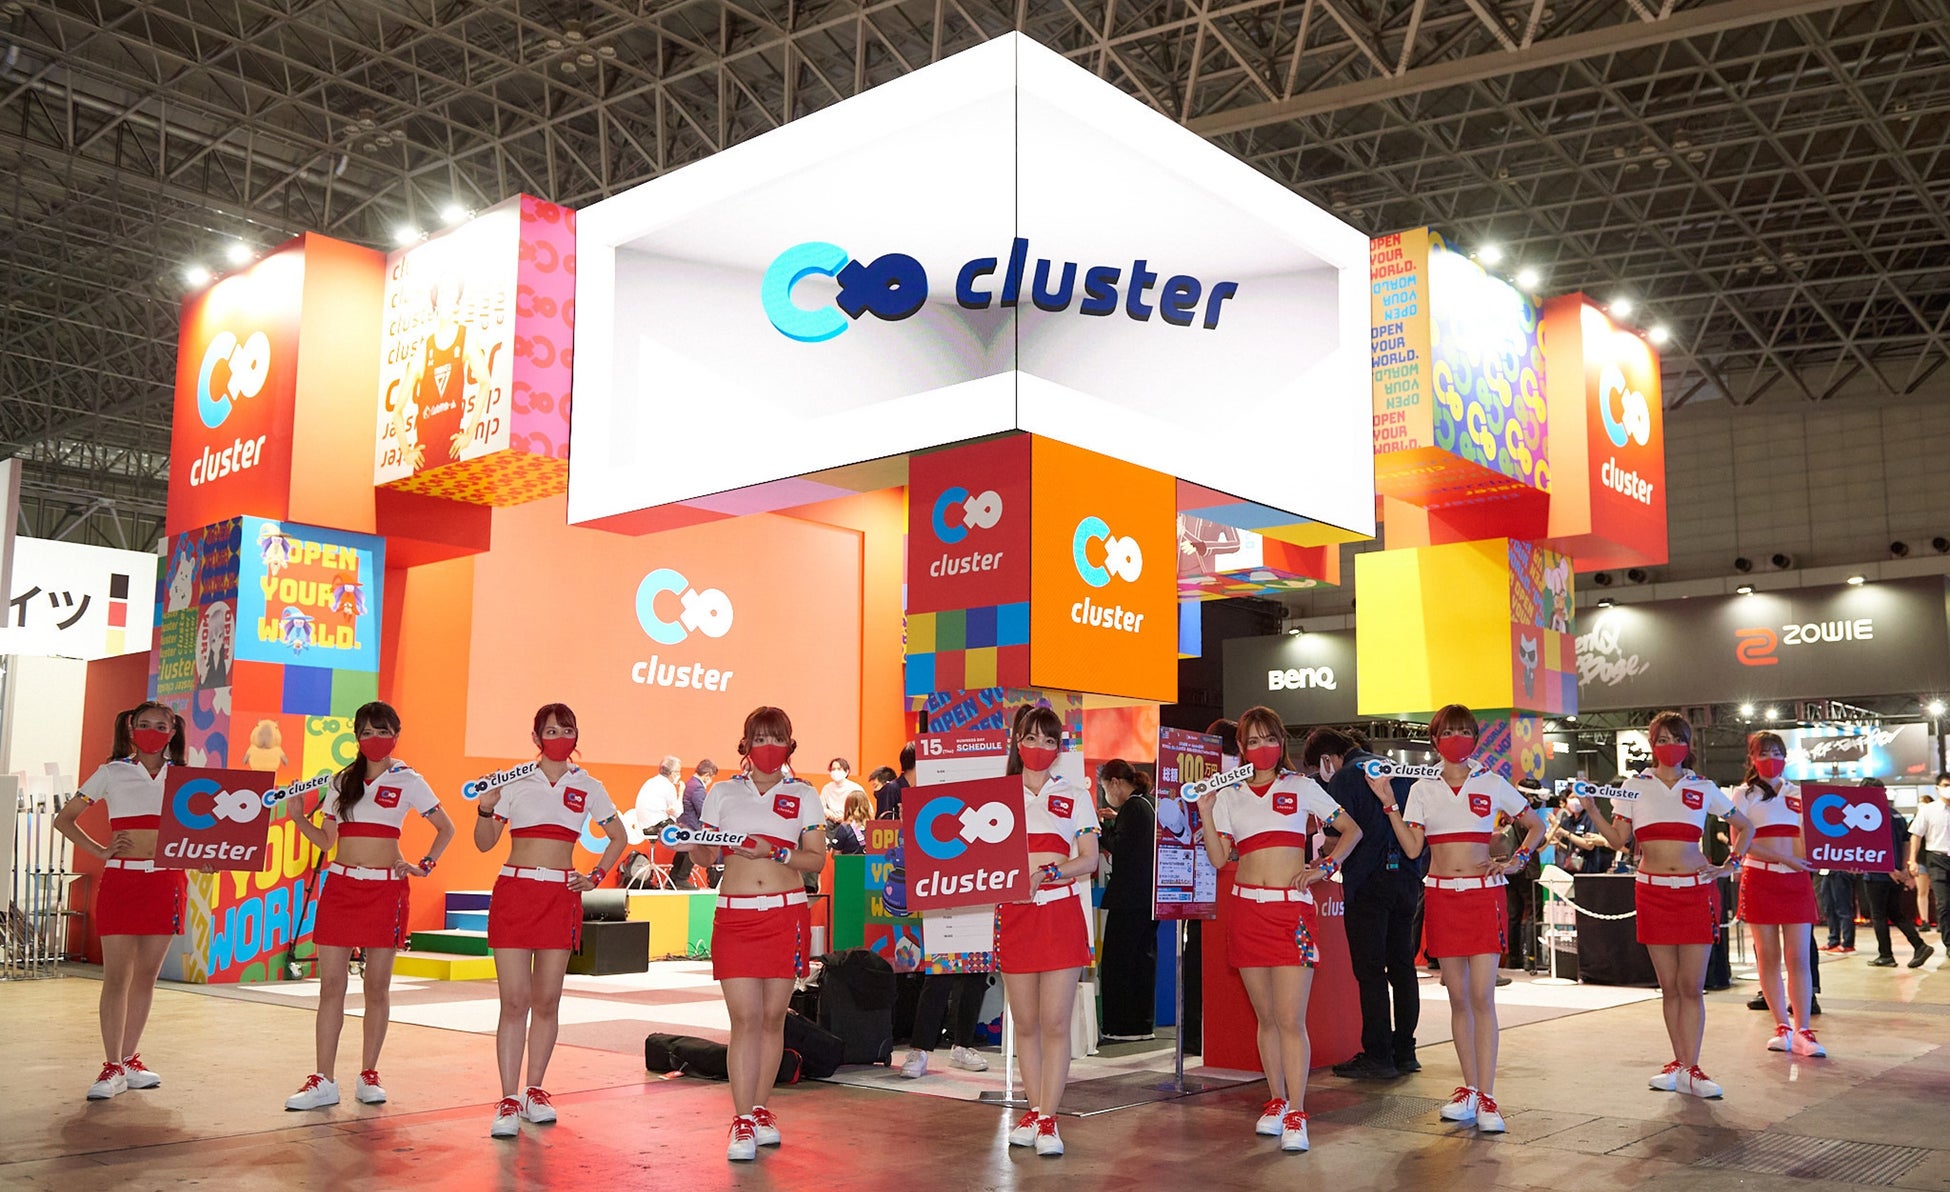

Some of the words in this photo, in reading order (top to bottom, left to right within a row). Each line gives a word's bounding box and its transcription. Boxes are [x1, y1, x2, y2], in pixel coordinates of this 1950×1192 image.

[1370, 232, 1401, 251] OPEN
[1370, 248, 1403, 265] YOUR
[955, 236, 1239, 330] cluster
[1383, 289, 1417, 306] YOUR
[1384, 303, 1417, 321] OPEN
[1371, 322, 1403, 339] OPEN
[1371, 337, 1405, 353] YOUR
[1372, 350, 1419, 368] WORLD.
[1384, 378, 1419, 395] YOUR
[1386, 393, 1420, 409] OPEN
[1373, 410, 1405, 427] OPEN
[1373, 425, 1407, 441] YOUR
[190, 435, 266, 486] cluster
[1601, 456, 1653, 505] cluster
[288, 538, 356, 571] OPEN
[929, 552, 1003, 577] cluster
[260, 575, 335, 608] YOUR
[1071, 596, 1144, 633] cluster
[258, 616, 362, 650] WLD.
[1782, 618, 1874, 645] ZOWIE
[158, 657, 196, 681] luster
[631, 655, 733, 692] cluster
[1268, 666, 1336, 691] BenQ
[920, 739, 943, 756] 15
[956, 742, 1002, 752] SCHEDULE
[491, 763, 534, 786] cluster
[1210, 766, 1252, 788] cluster
[1395, 765, 1439, 777] cluster
[289, 775, 329, 795] cluster
[1600, 786, 1640, 799] cluster
[694, 831, 744, 843] cluster
[164, 837, 258, 860] cluster
[1812, 843, 1886, 863] cluster
[915, 868, 1019, 898] cluster
[1321, 896, 1345, 917] clus
